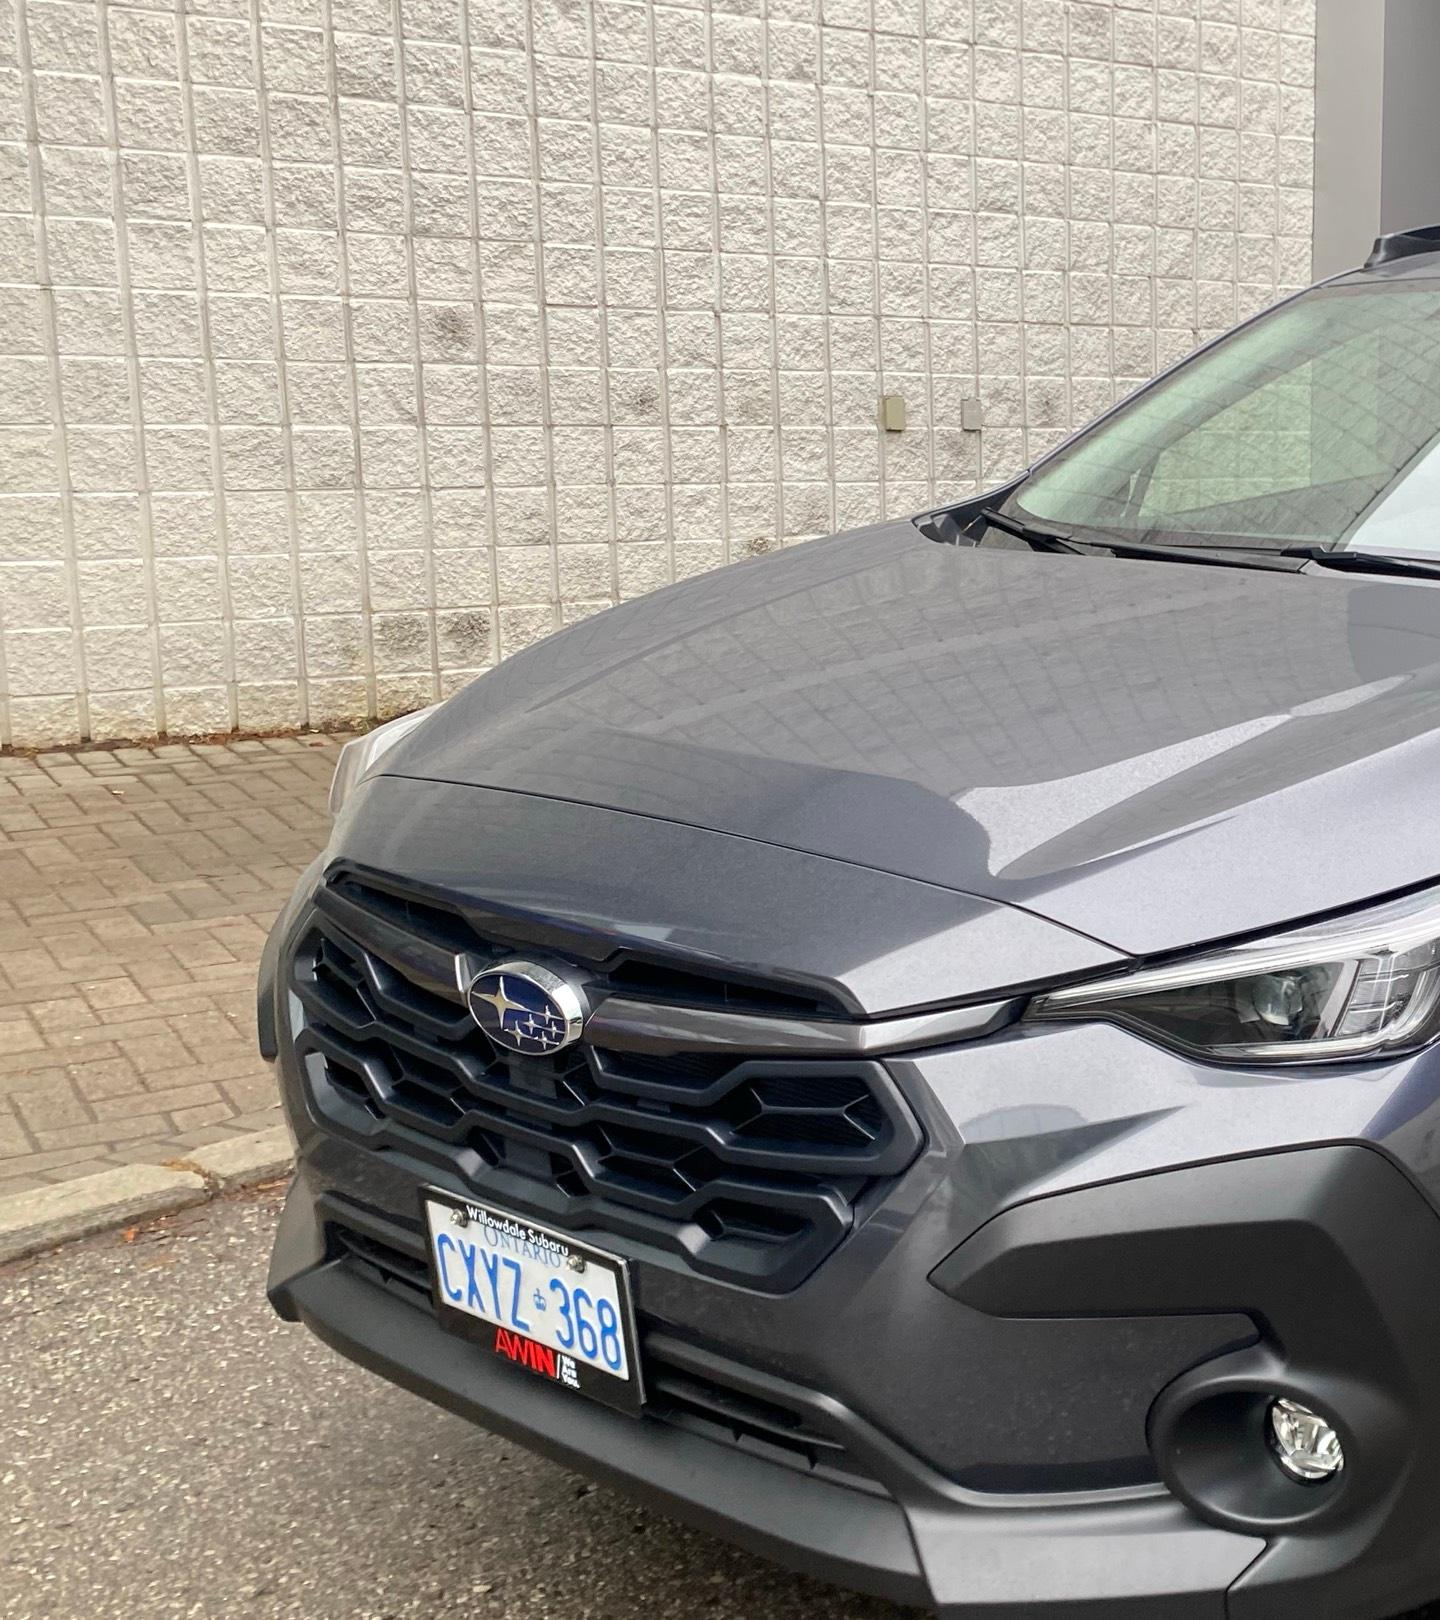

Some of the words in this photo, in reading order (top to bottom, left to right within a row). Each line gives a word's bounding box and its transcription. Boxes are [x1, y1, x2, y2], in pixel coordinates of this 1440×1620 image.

[466, 1205, 526, 1239] Willowdale
[528, 1229, 569, 1257] Subaru
[484, 1225, 561, 1268] ONTARIO
[437, 1233, 530, 1332] CXYZ
[550, 1277, 622, 1371] 368
[496, 1328, 556, 1378] AWIN
